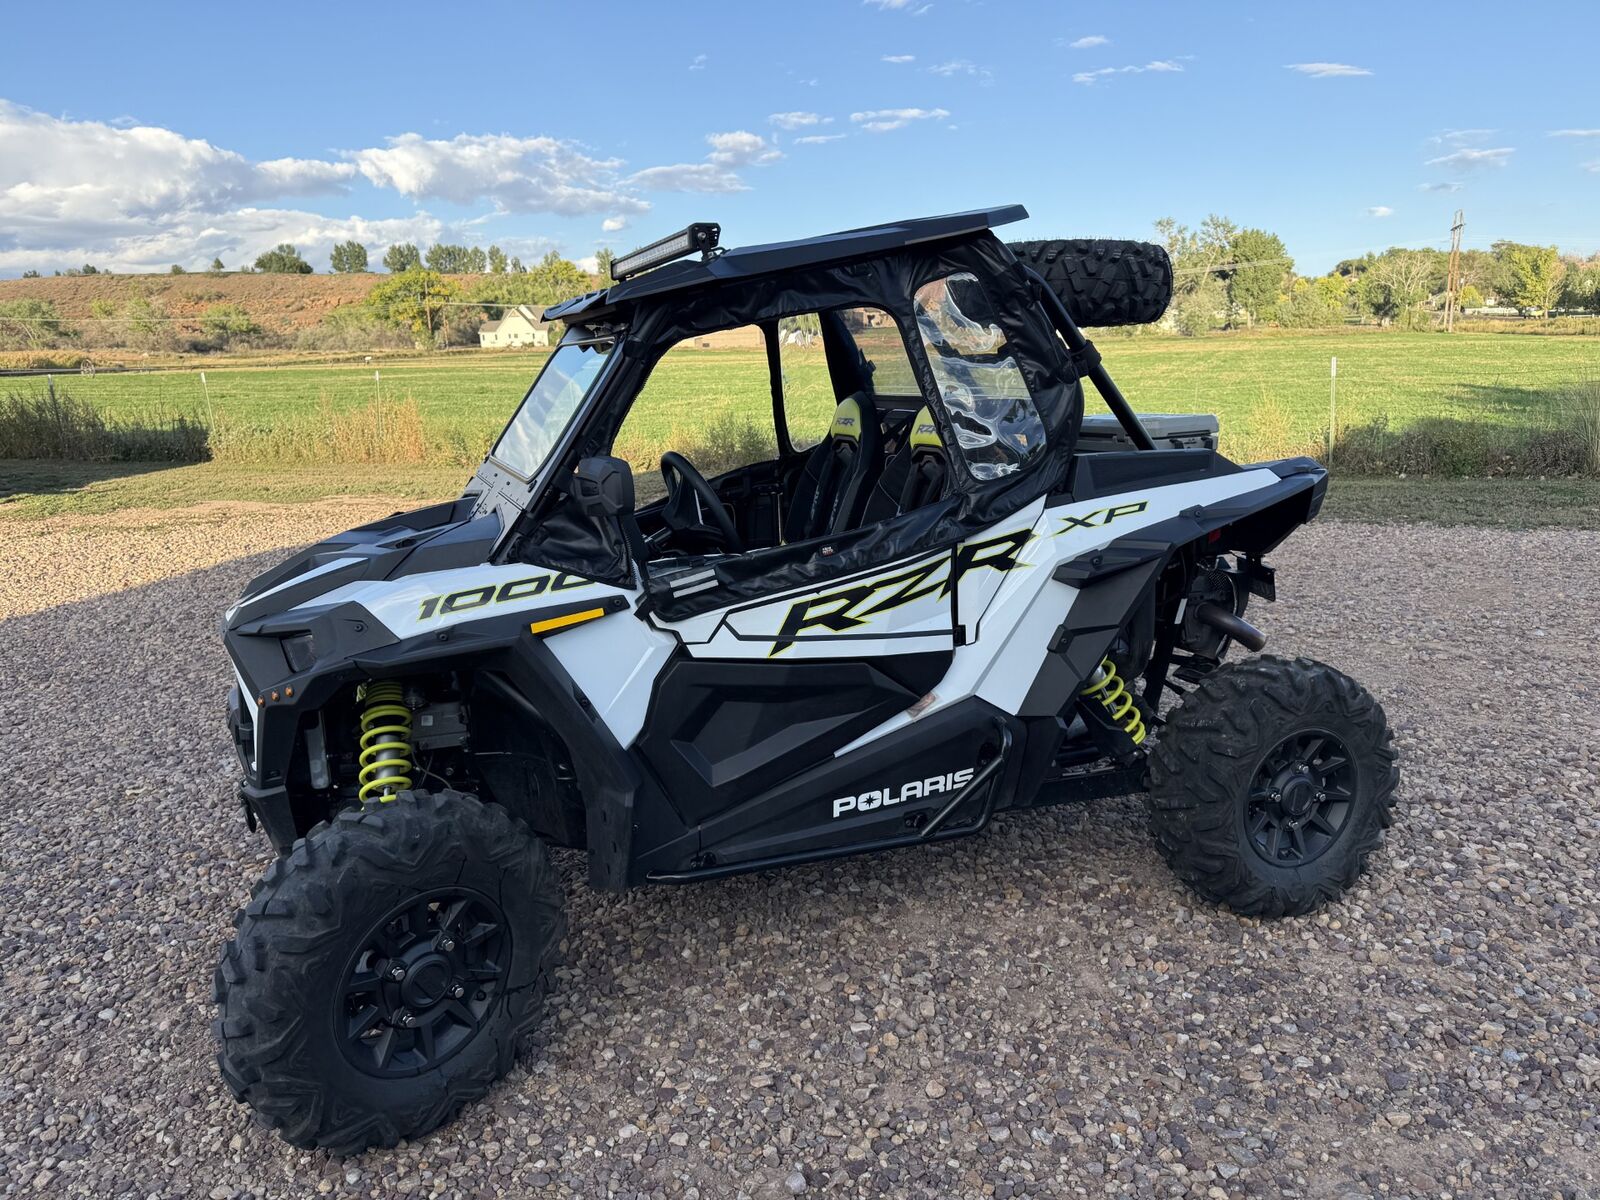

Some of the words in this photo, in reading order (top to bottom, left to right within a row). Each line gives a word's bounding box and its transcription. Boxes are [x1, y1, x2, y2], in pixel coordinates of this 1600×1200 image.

[836, 417, 855, 426] RZR
[1052, 501, 1149, 536] XP
[768, 527, 1040, 658] RZR
[832, 768, 975, 818] POLARIS
